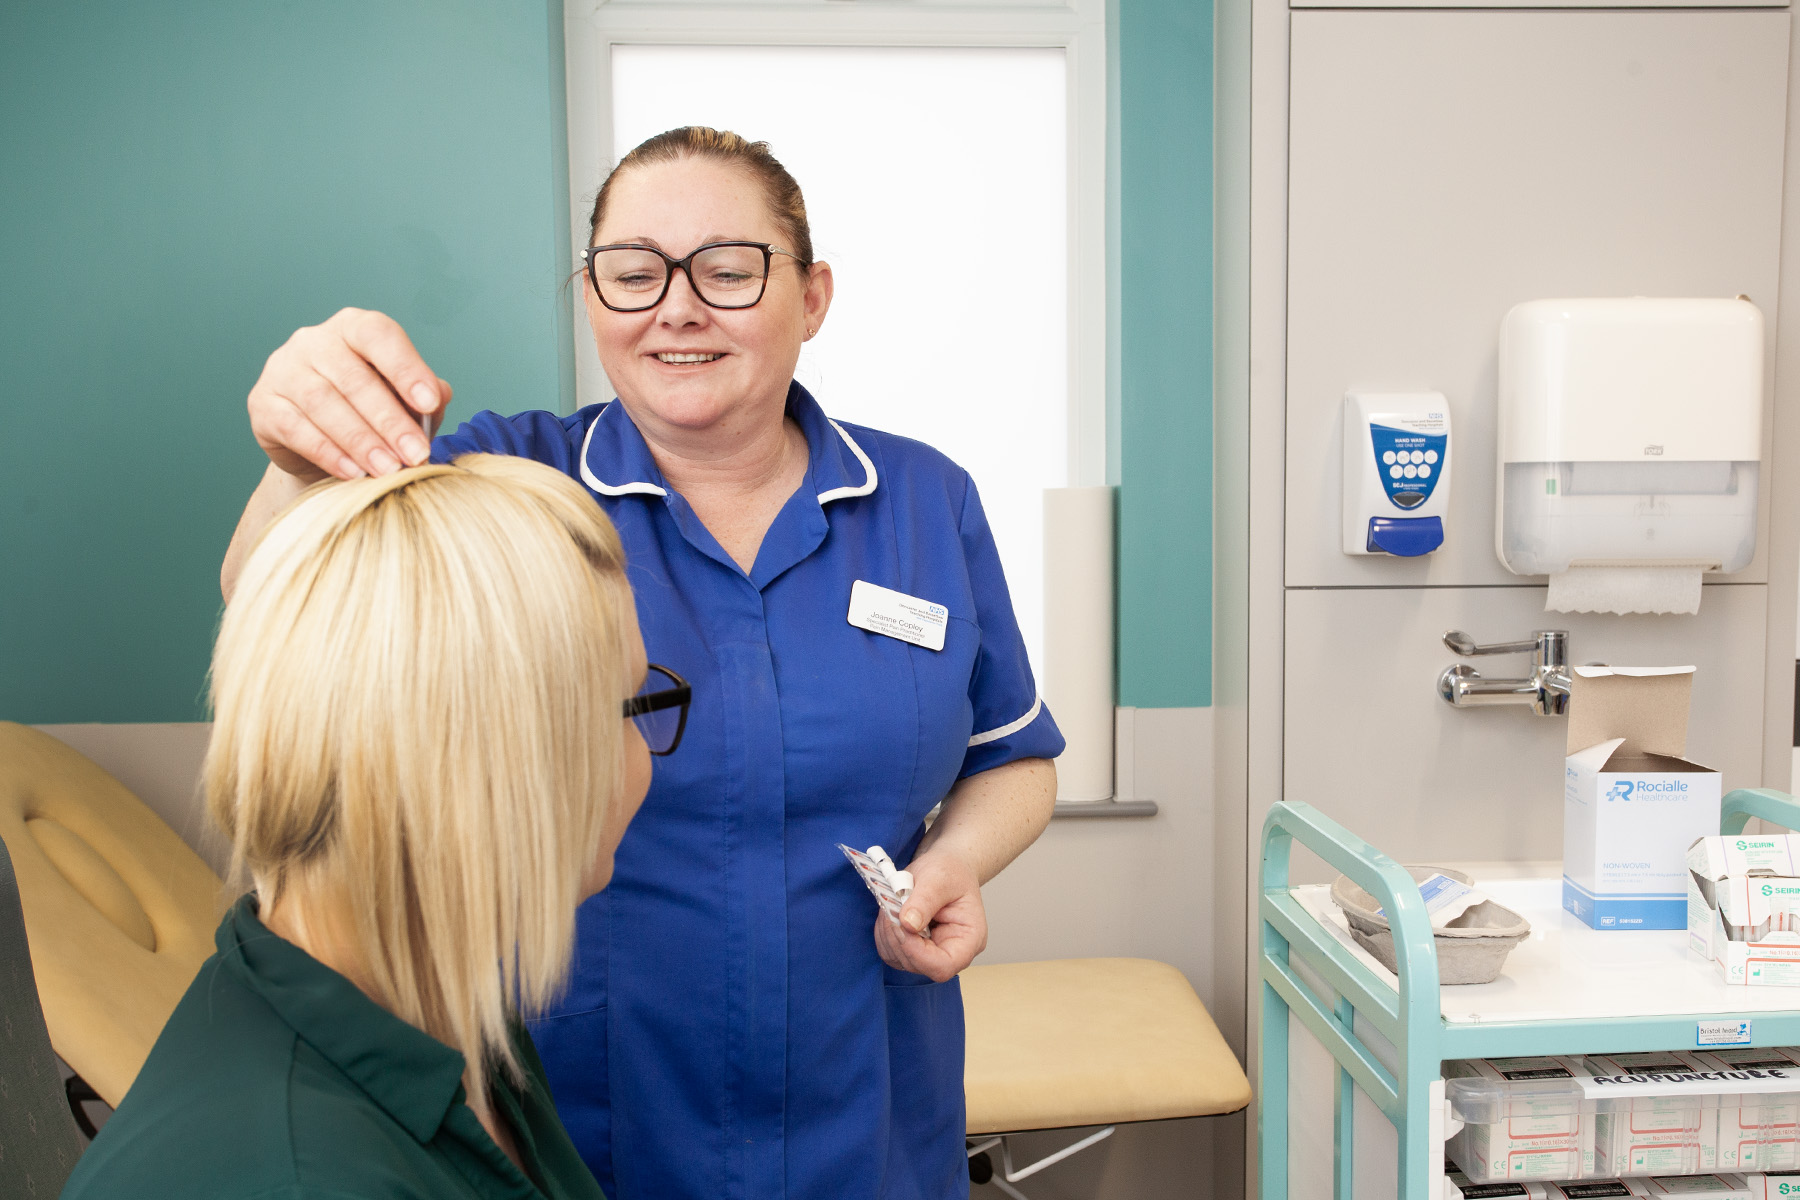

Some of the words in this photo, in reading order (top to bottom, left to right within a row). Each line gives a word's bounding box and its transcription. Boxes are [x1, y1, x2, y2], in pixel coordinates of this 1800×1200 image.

[870, 611, 897, 624] Joanne
[1636, 780, 1689, 792] Rocialle
[1636, 793, 1689, 802] Healthcare
[1700, 1027, 1721, 1035] Bristol
[1593, 1069, 1790, 1085] ACUPUNCTURE
